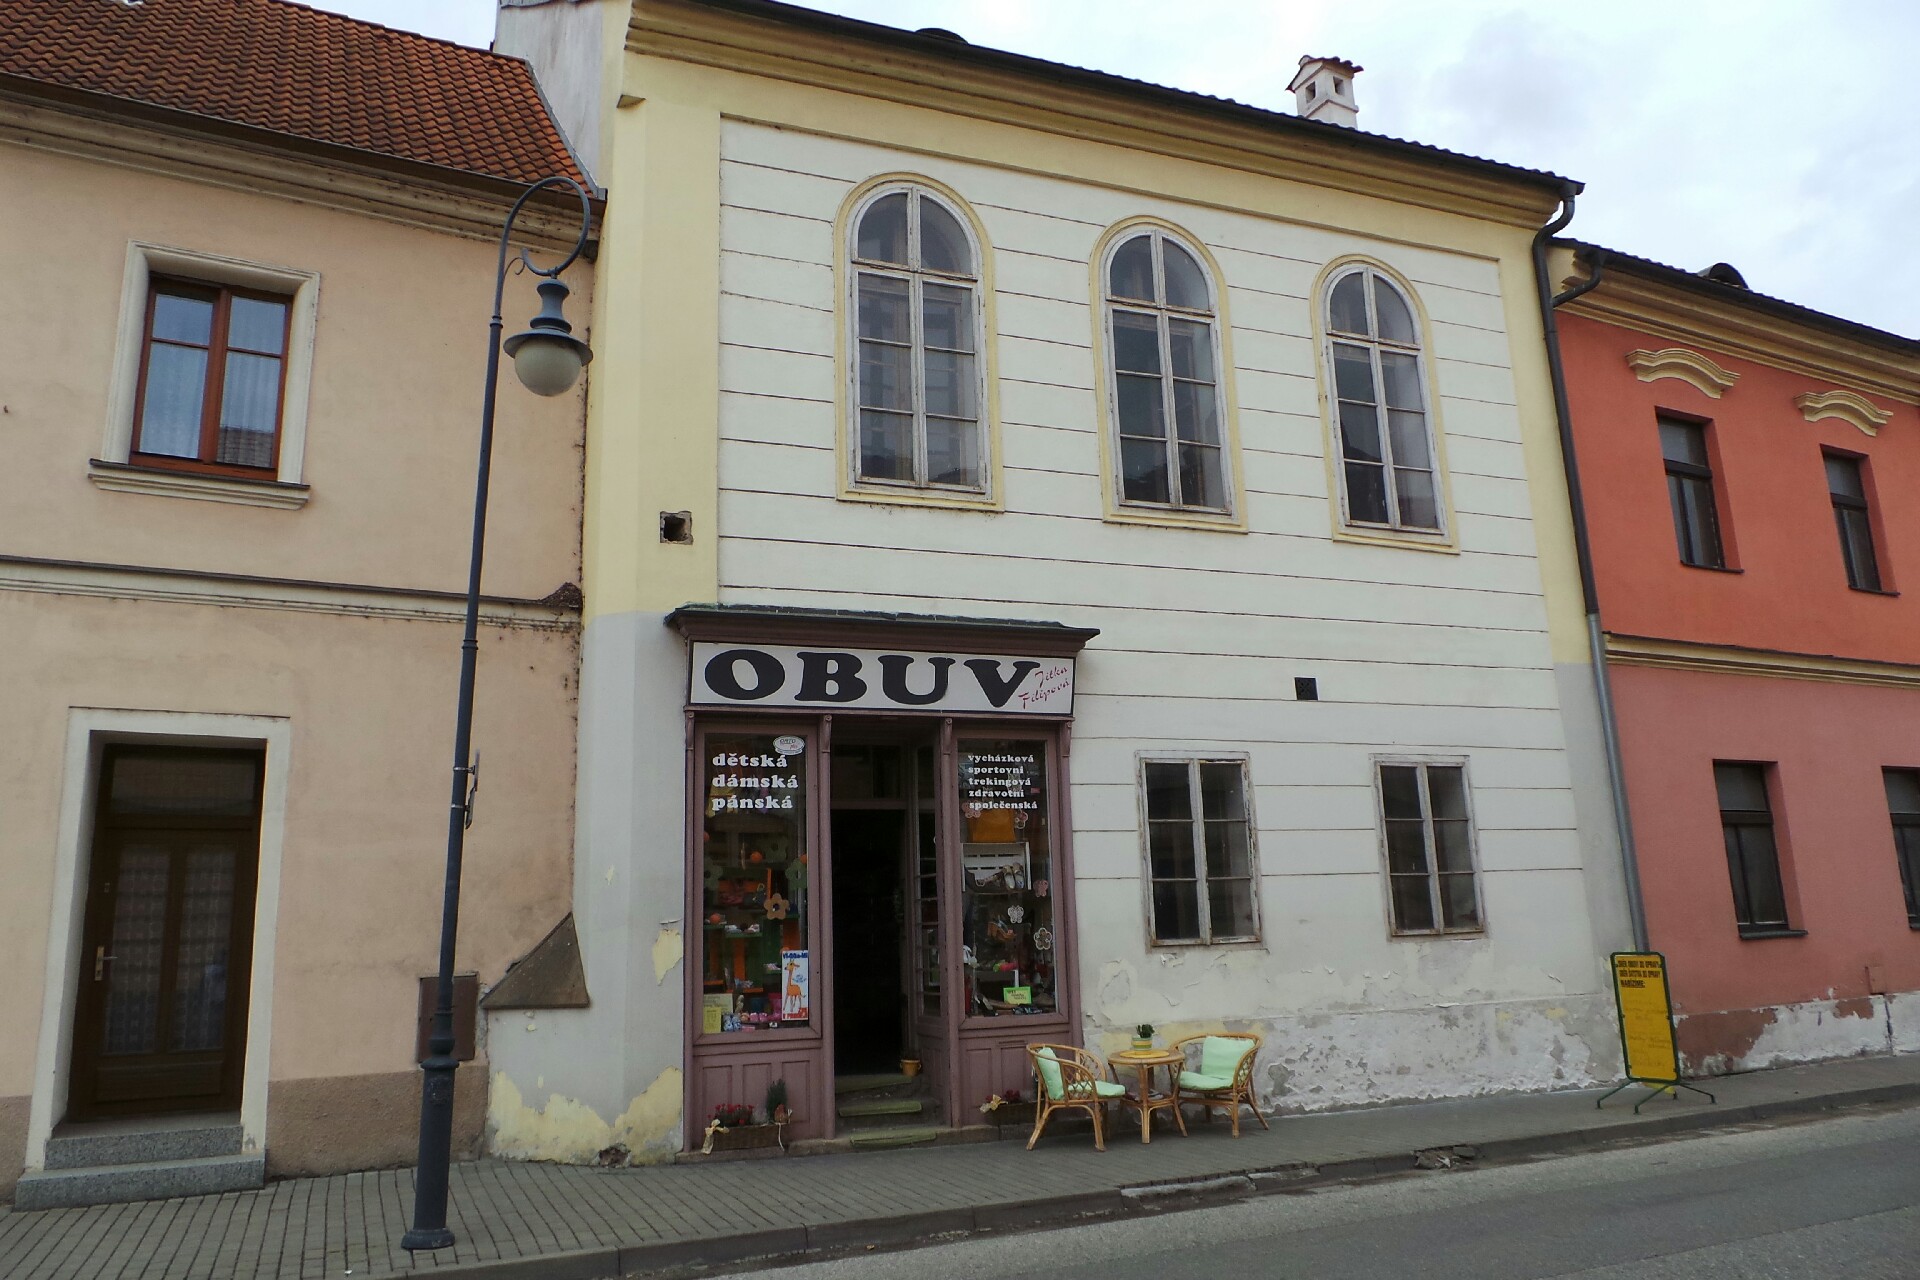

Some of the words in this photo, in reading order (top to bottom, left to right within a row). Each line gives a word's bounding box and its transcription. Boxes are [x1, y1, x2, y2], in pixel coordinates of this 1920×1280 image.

[704, 648, 1041, 708] OBUV
[1035, 666, 1068, 688] Jitka
[1018, 678, 1070, 709] Filipová
[712, 753, 788, 768] dětská
[968, 754, 1034, 763] vycházková
[712, 774, 799, 789] dámská
[968, 778, 1032, 788] trekingová
[712, 795, 793, 811] pánská
[969, 801, 1038, 810] společenská
